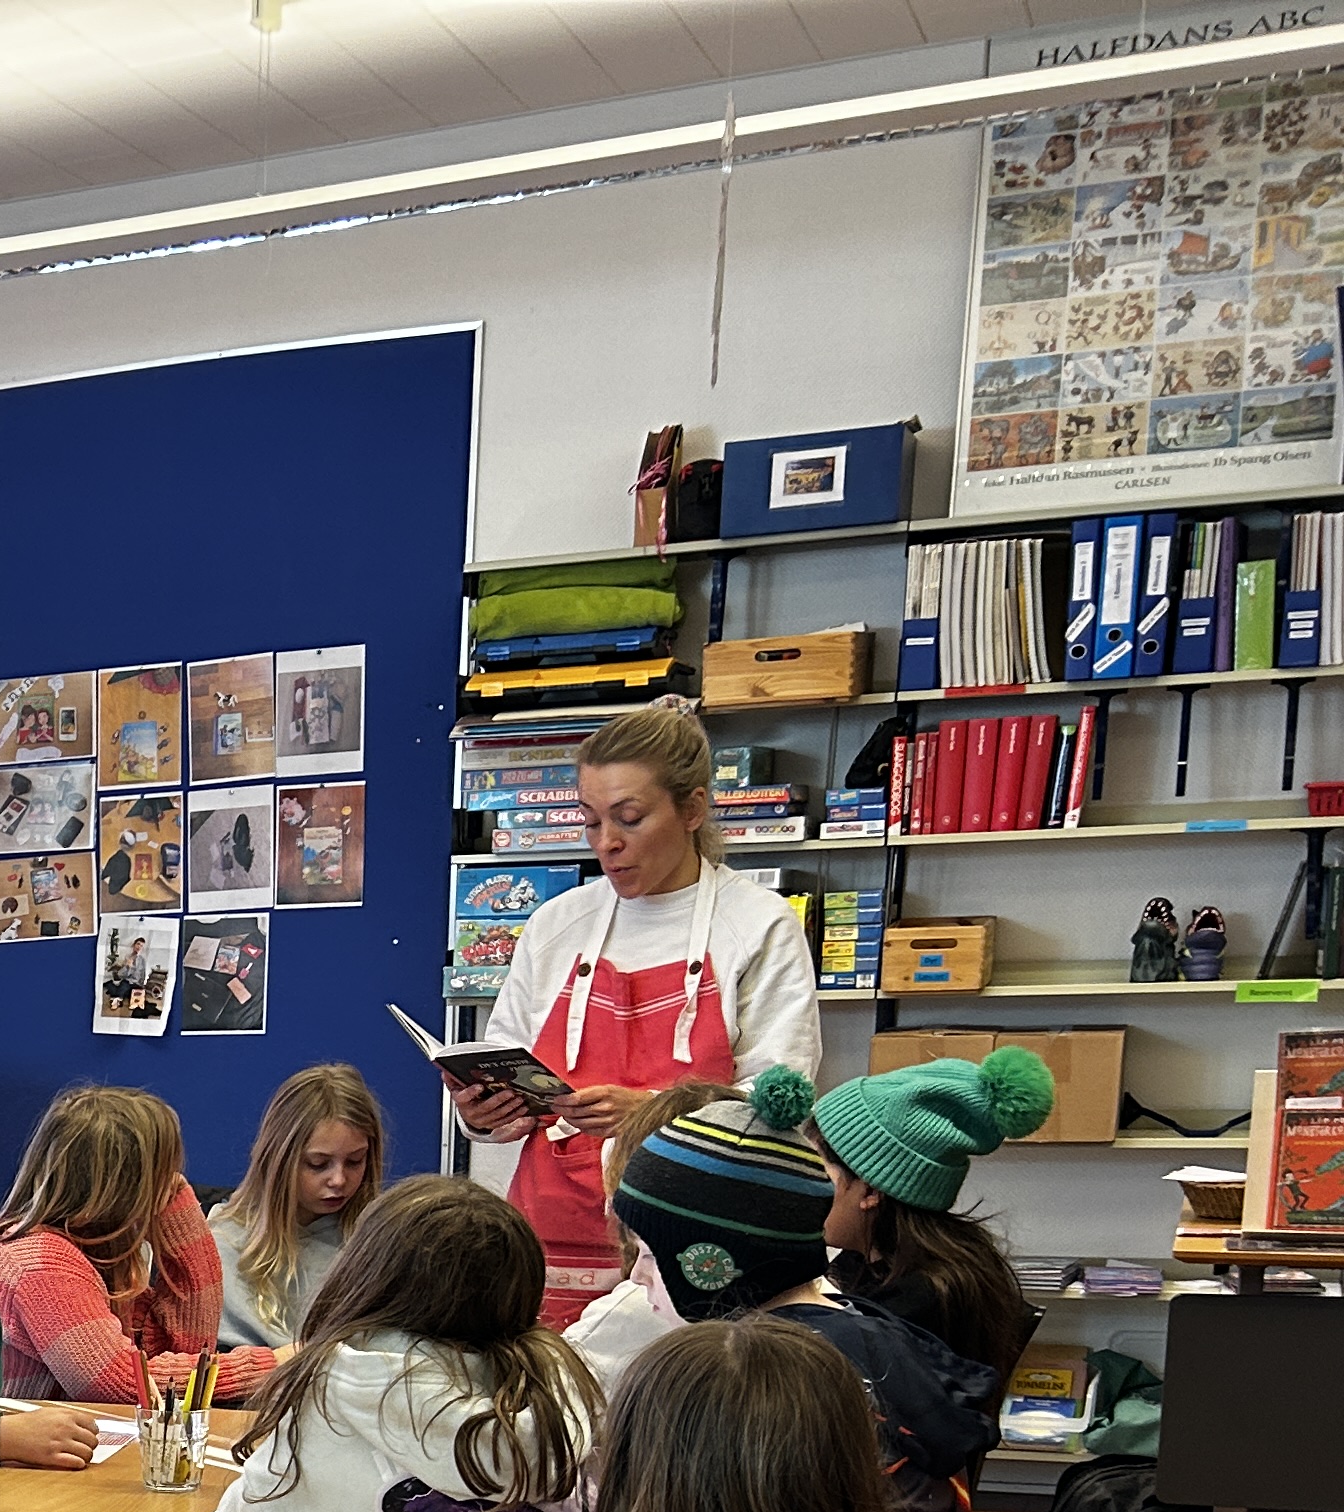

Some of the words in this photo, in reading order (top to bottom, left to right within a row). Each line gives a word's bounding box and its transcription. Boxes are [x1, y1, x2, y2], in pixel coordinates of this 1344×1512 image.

[1035, 20, 1233, 67] HALFDANS
[1247, 5, 1325, 36] ABC
[1063, 465, 1135, 481] Rasmussen
[1230, 453, 1271, 470] Spang
[1273, 449, 1312, 465] Olsen
[1115, 475, 1172, 491] CARLSEN
[519, 790, 580, 804] SCRABBL
[549, 810, 586, 823] SCRA
[685, 1245, 721, 1262] DUSTY
